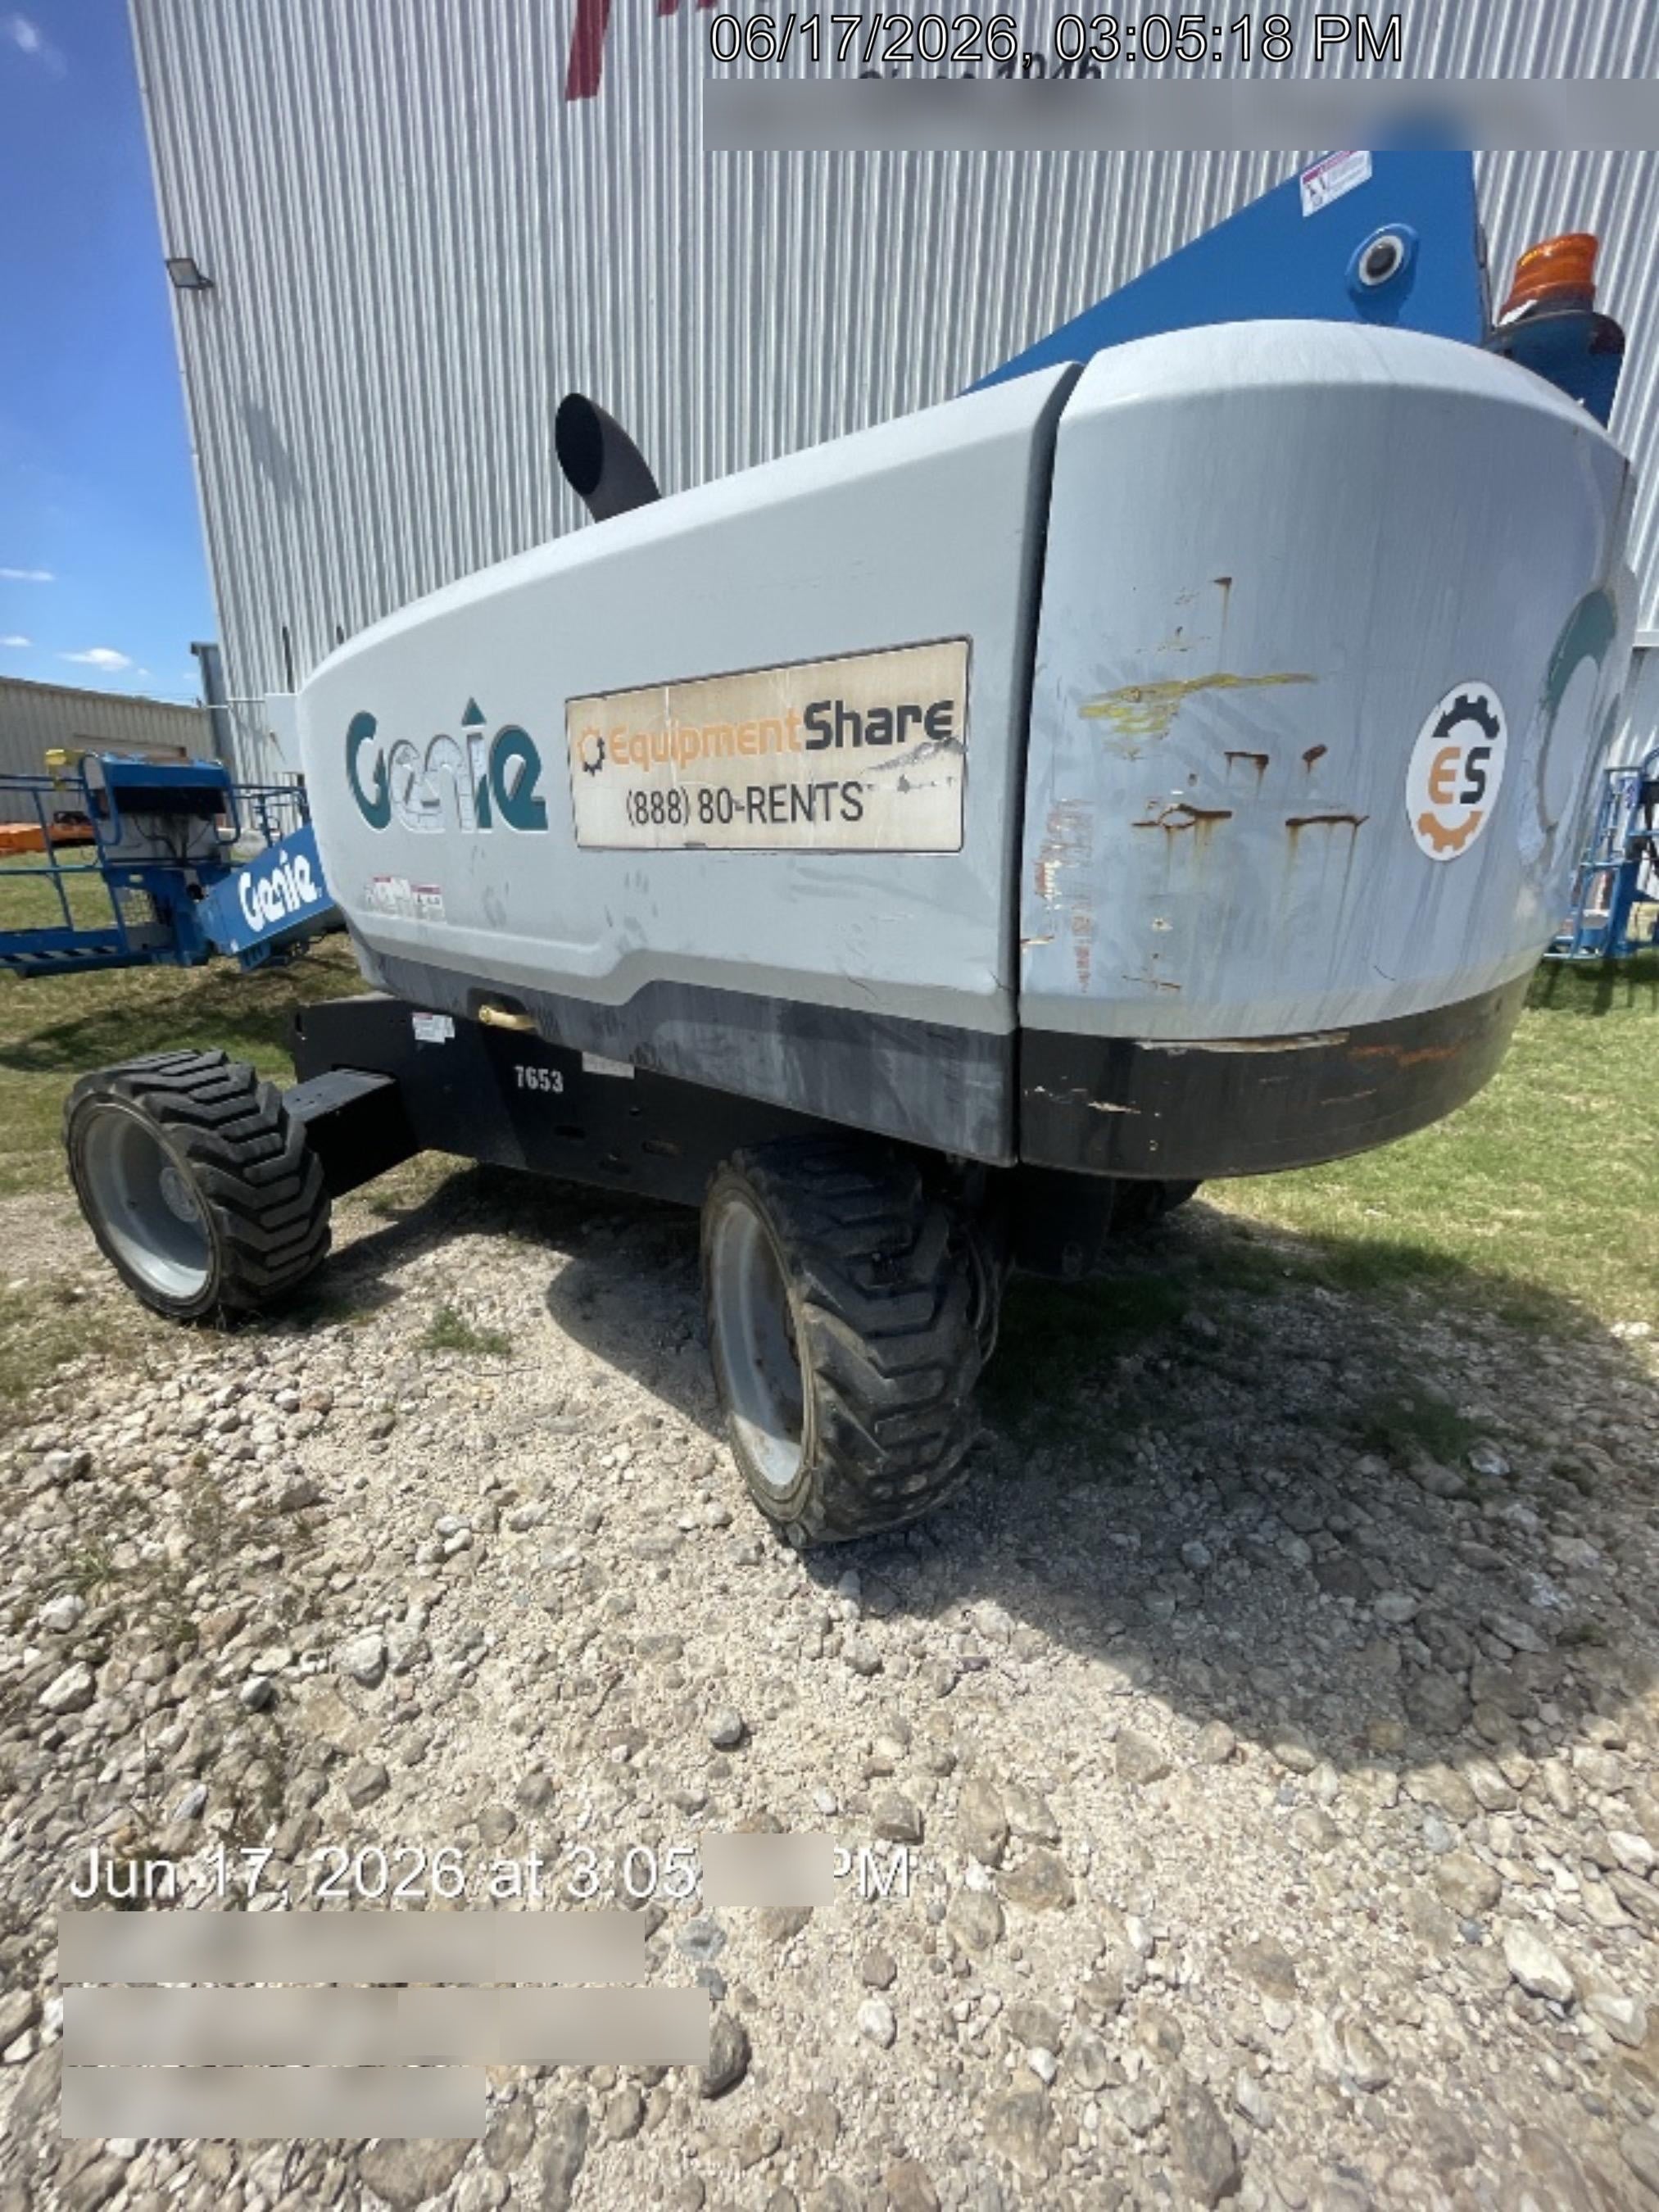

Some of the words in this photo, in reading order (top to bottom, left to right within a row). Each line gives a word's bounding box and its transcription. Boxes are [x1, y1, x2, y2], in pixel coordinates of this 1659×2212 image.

[346, 696, 550, 832] Genie
[609, 700, 954, 772] EquipmentShare
[626, 788, 689, 827] (888)
[698, 781, 864, 825] 80-RENTS
[1428, 746, 1492, 804] ES
[238, 849, 318, 931] Genie
